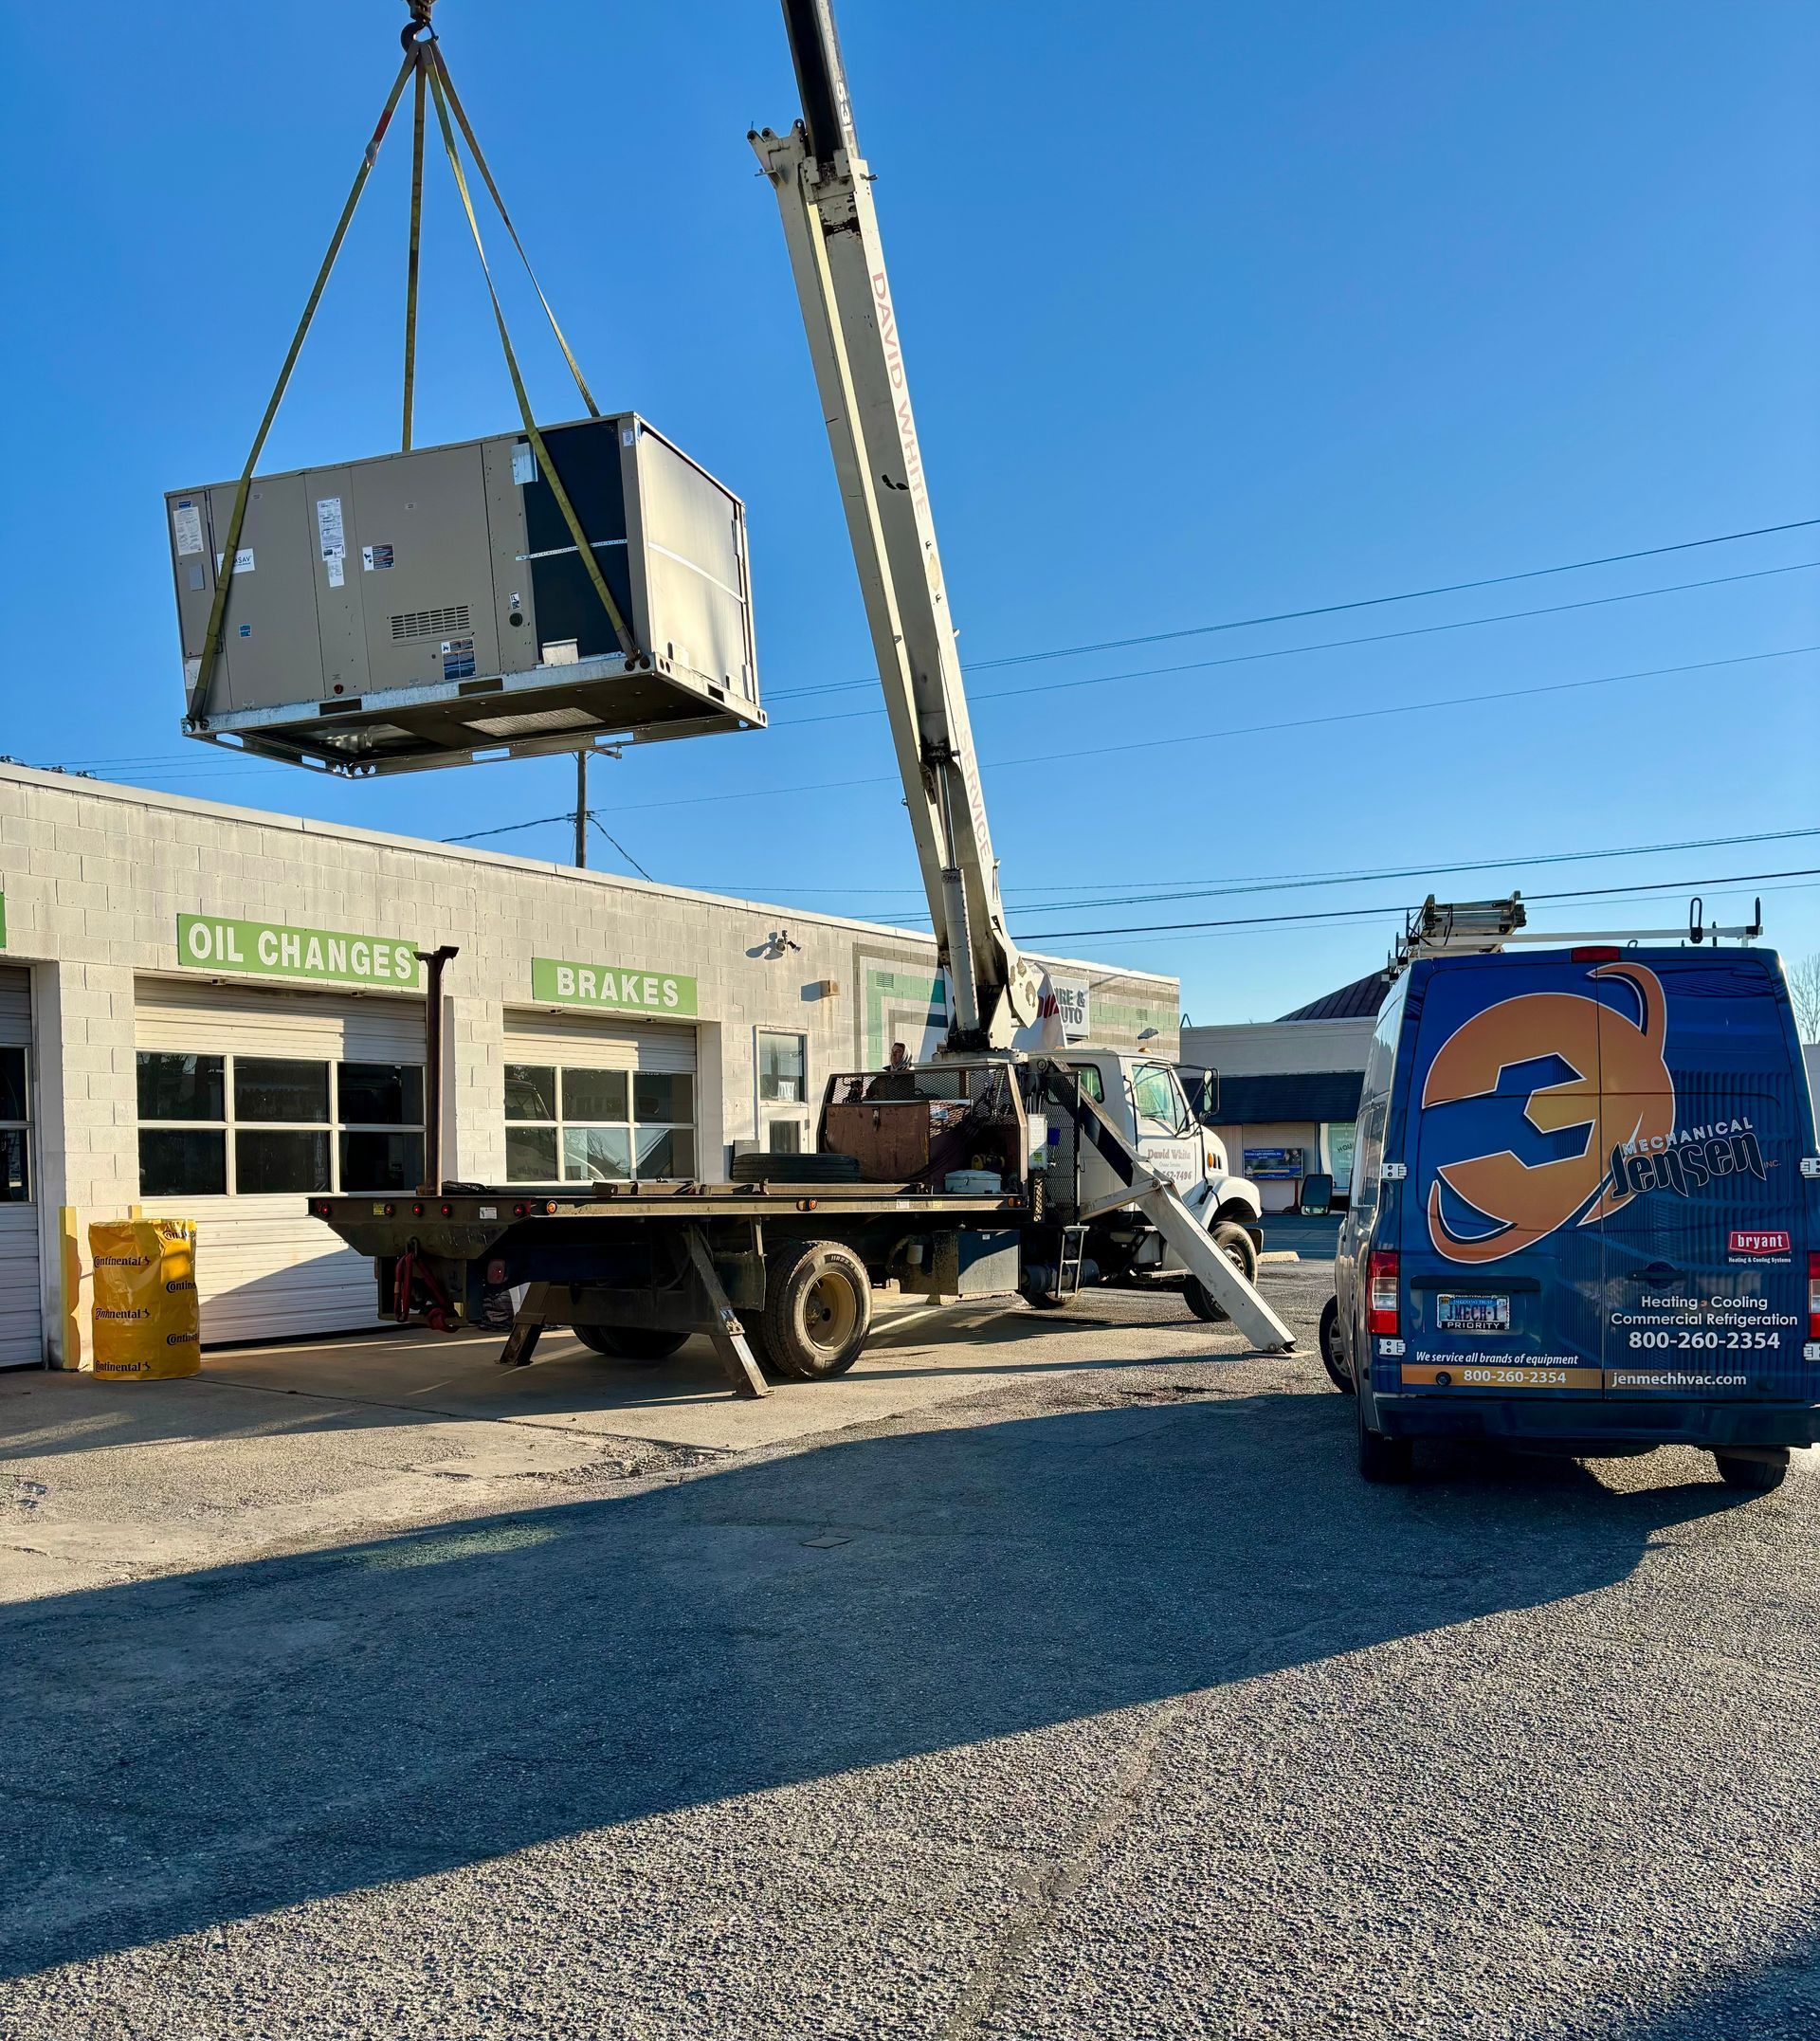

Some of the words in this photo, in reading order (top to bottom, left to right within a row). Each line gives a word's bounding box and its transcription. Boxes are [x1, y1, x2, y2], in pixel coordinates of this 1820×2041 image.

[872, 272, 903, 390] DAVID
[898, 400, 930, 520] WHITE
[233, 555, 250, 565] SAV
[959, 729, 991, 863] SERVICE
[189, 922, 244, 962] OIL
[257, 930, 412, 979] CHANGES
[556, 966, 679, 1008] BRAKES
[1054, 987, 1074, 1006] IRE
[1077, 990, 1085, 1008] &
[1061, 1006, 1083, 1025] UTO
[1621, 1116, 1754, 1156] MECHANICAL
[1148, 1148, 1170, 1159] David
[1338, 1143, 1353, 1154] HOU
[1610, 1132, 1767, 1199] Jensen
[1763, 1159, 1782, 1169] INC.
[1738, 1234, 1783, 1249] bryant
[94, 1255, 141, 1268] Continental
[1641, 1295, 1698, 1310] Heating
[1711, 1296, 1768, 1311] Cooling
[1611, 1313, 1702, 1325] Commercial
[1706, 1313, 1798, 1327] Refrigeration
[1629, 1331, 1780, 1349] 800-260-2354
[1416, 1351, 1430, 1361] We
[1431, 1352, 1465, 1362] service
[1465, 1353, 1480, 1363] all
[1480, 1353, 1513, 1363] brands
[1514, 1354, 1526, 1364] of
[1526, 1355, 1578, 1366] equipment
[1464, 1369, 1567, 1384] 800-260-2354
[1611, 1372, 1747, 1388] jenmechhvac.com
